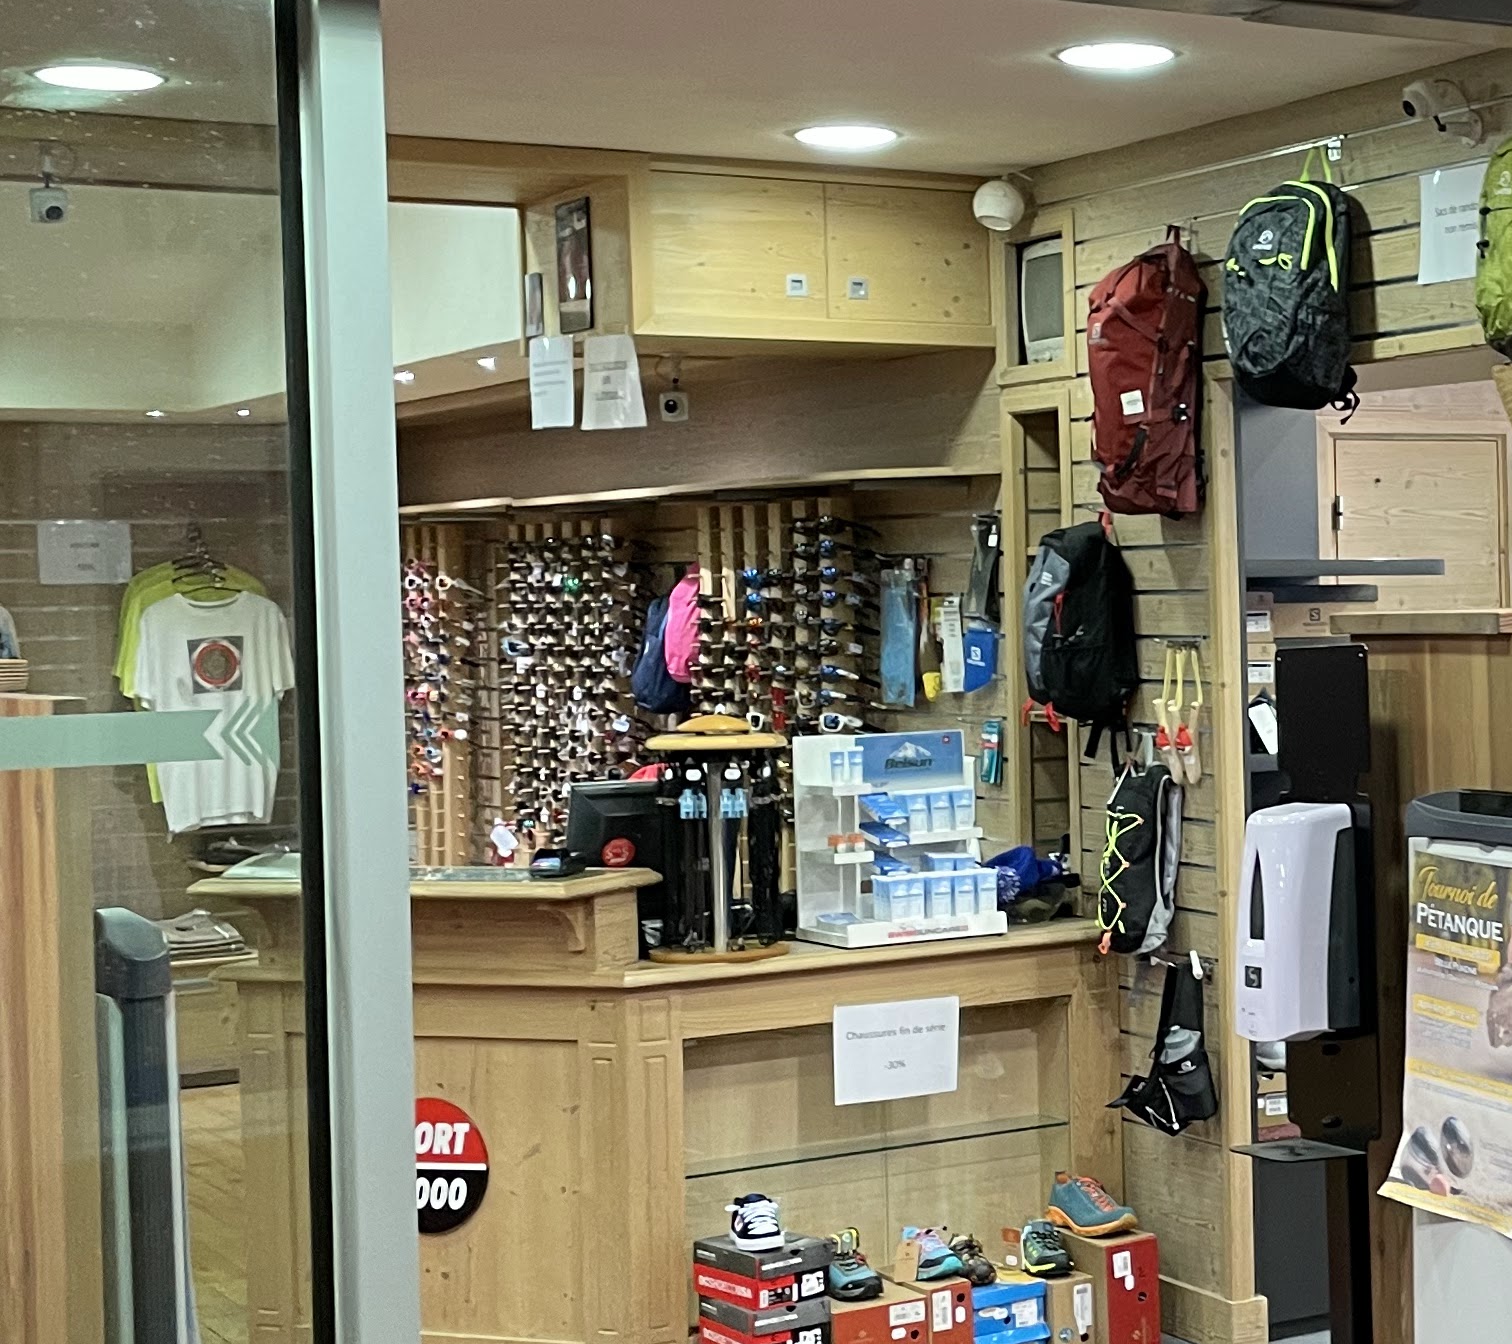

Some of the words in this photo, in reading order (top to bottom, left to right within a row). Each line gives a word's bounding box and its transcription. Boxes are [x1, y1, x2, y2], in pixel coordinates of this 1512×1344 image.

[1419, 866, 1477, 905] Tournoi
[1476, 881, 1499, 910] de
[1416, 902, 1504, 942] PÉTANQUE
[846, 1029, 897, 1040] Chaussures
[899, 1026, 911, 1035] fin
[912, 1025, 924, 1034] de
[415, 1121, 470, 1155] ORT
[416, 1177, 468, 1211] 000
